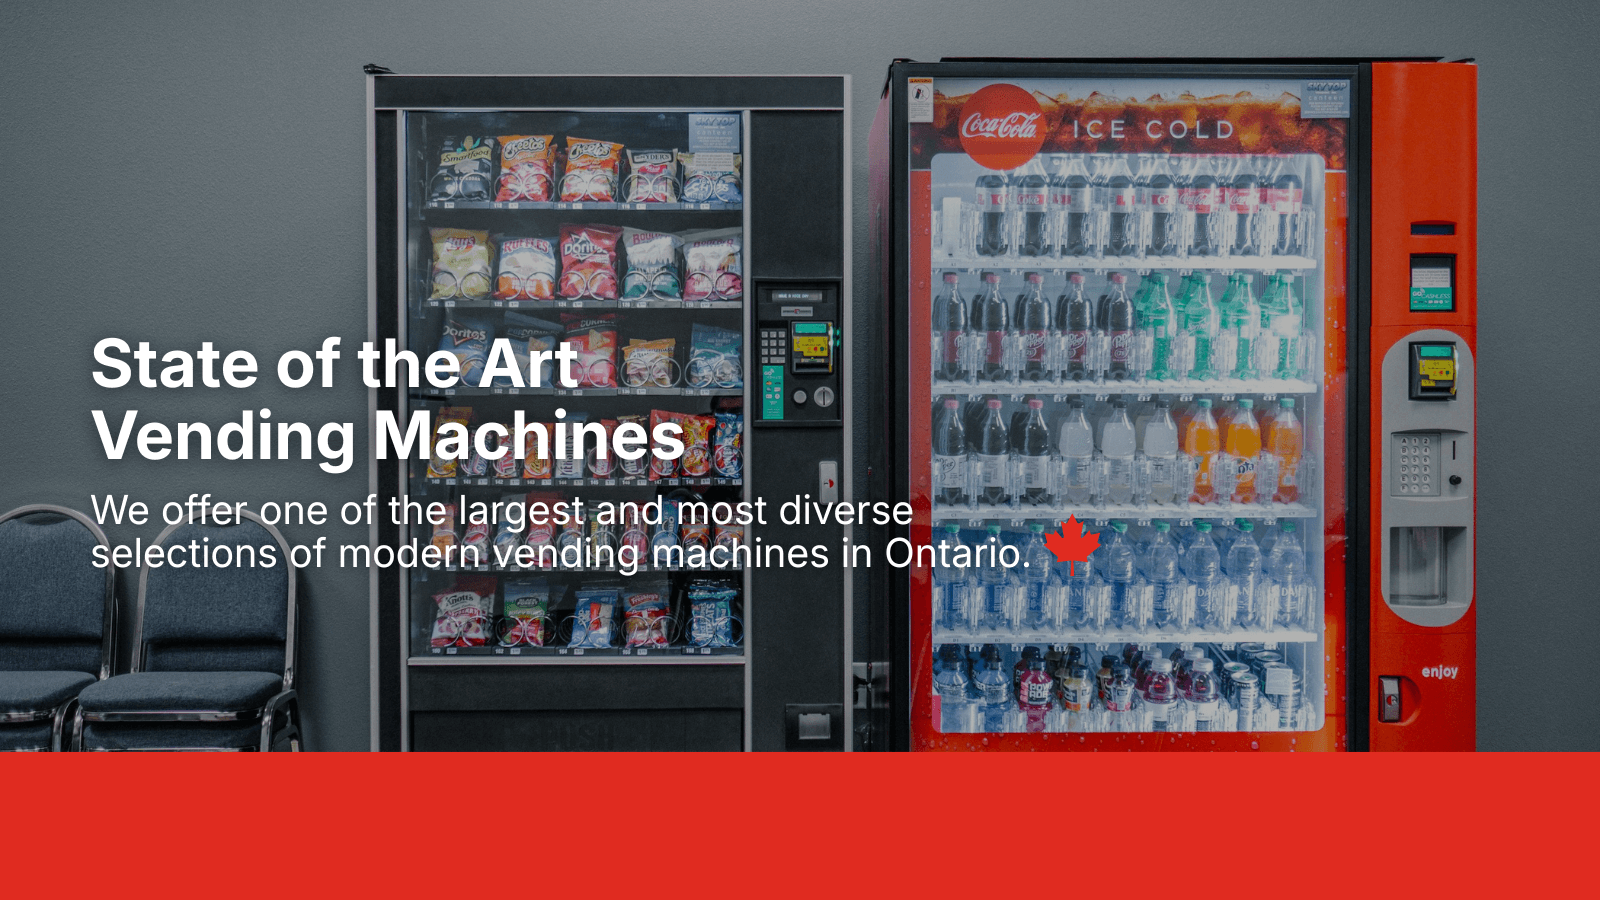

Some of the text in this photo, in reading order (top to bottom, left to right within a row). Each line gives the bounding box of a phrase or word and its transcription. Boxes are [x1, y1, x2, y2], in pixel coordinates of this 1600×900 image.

[962, 112, 1041, 138] Coca-Cola
[1074, 120, 1234, 139] ICE COLD
[443, 150, 489, 163] Smartfood
[503, 137, 547, 160] Cheetos
[569, 142, 611, 161] Cheetos
[1018, 194, 1040, 205] Coke
[503, 238, 548, 253] RUFFLES
[443, 325, 486, 340] Doritos
[501, 435, 514, 473] TWX
[446, 594, 474, 605] Knott's
[1422, 664, 1458, 680] enjoy
